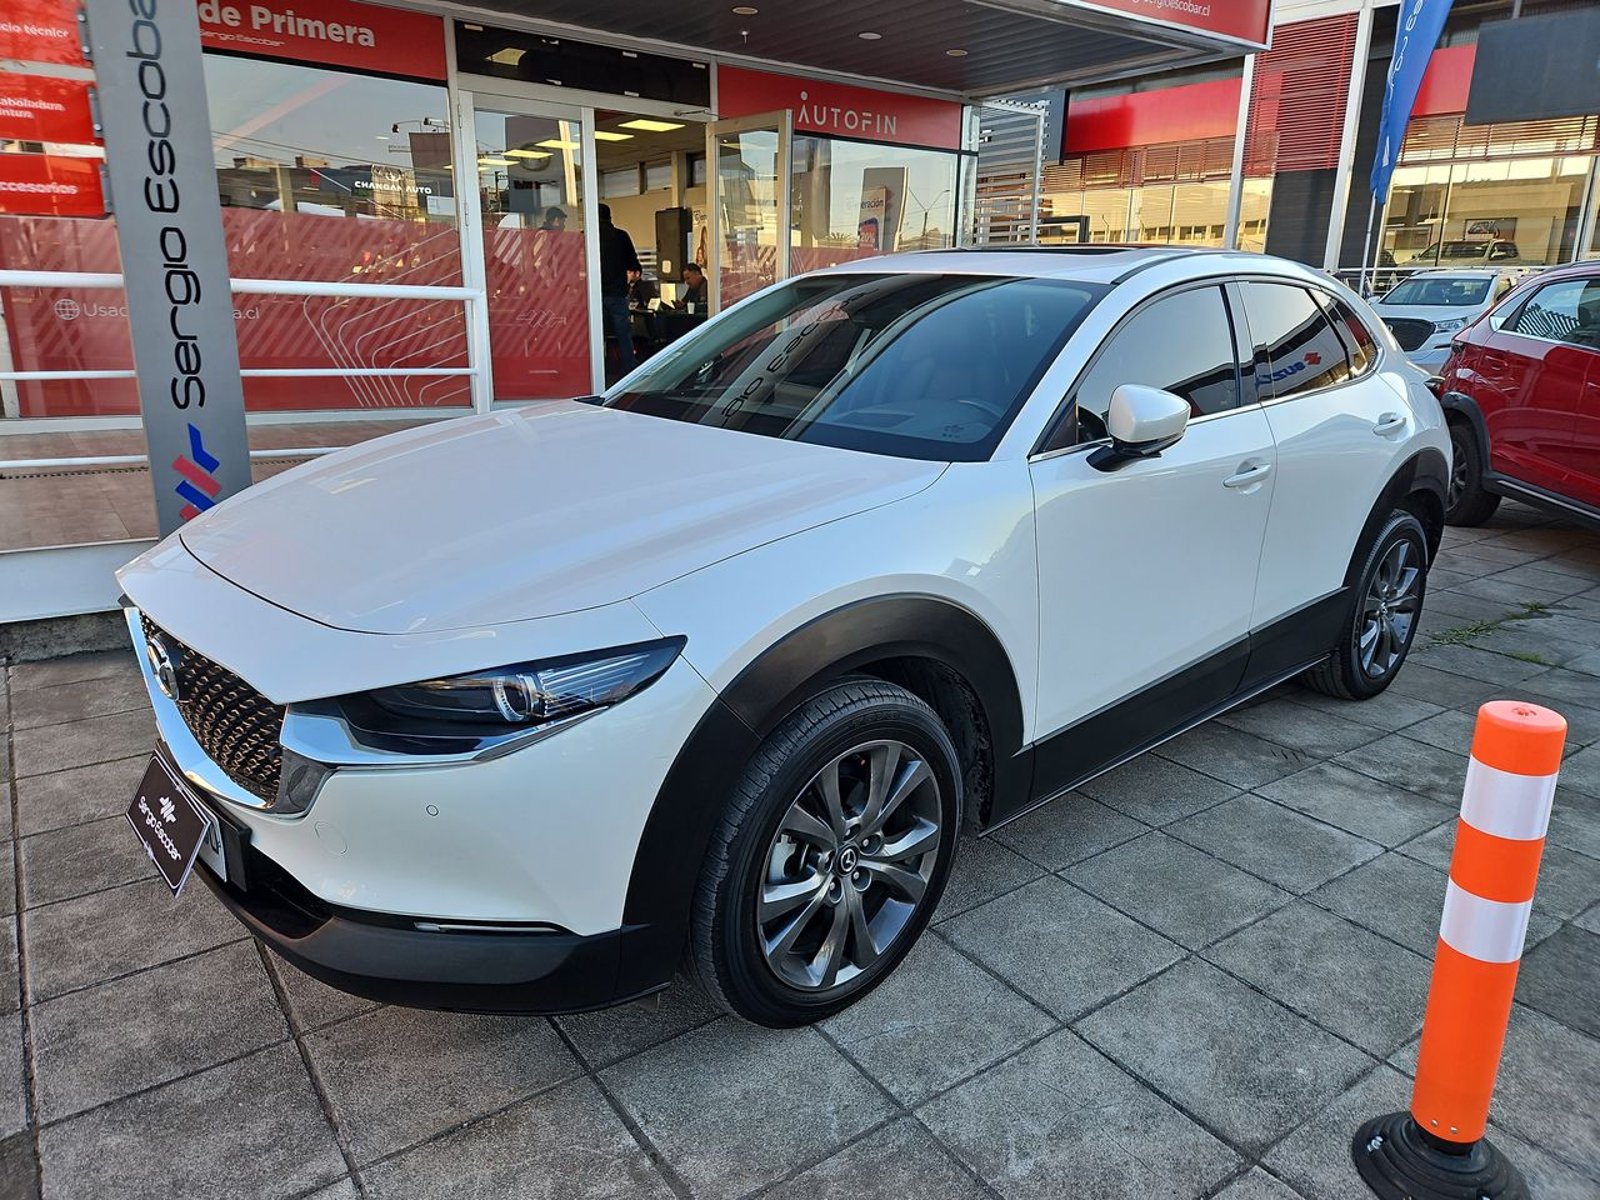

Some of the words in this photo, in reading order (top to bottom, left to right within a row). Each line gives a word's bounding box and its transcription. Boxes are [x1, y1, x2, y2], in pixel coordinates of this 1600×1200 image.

[199, 0, 241, 26] de
[251, 5, 375, 47] Primera
[798, 91, 896, 135] AUTOFIN
[354, 180, 402, 192] CHANGAN
[405, 185, 432, 194] AUTO
[160, 227, 206, 410] Sergio
